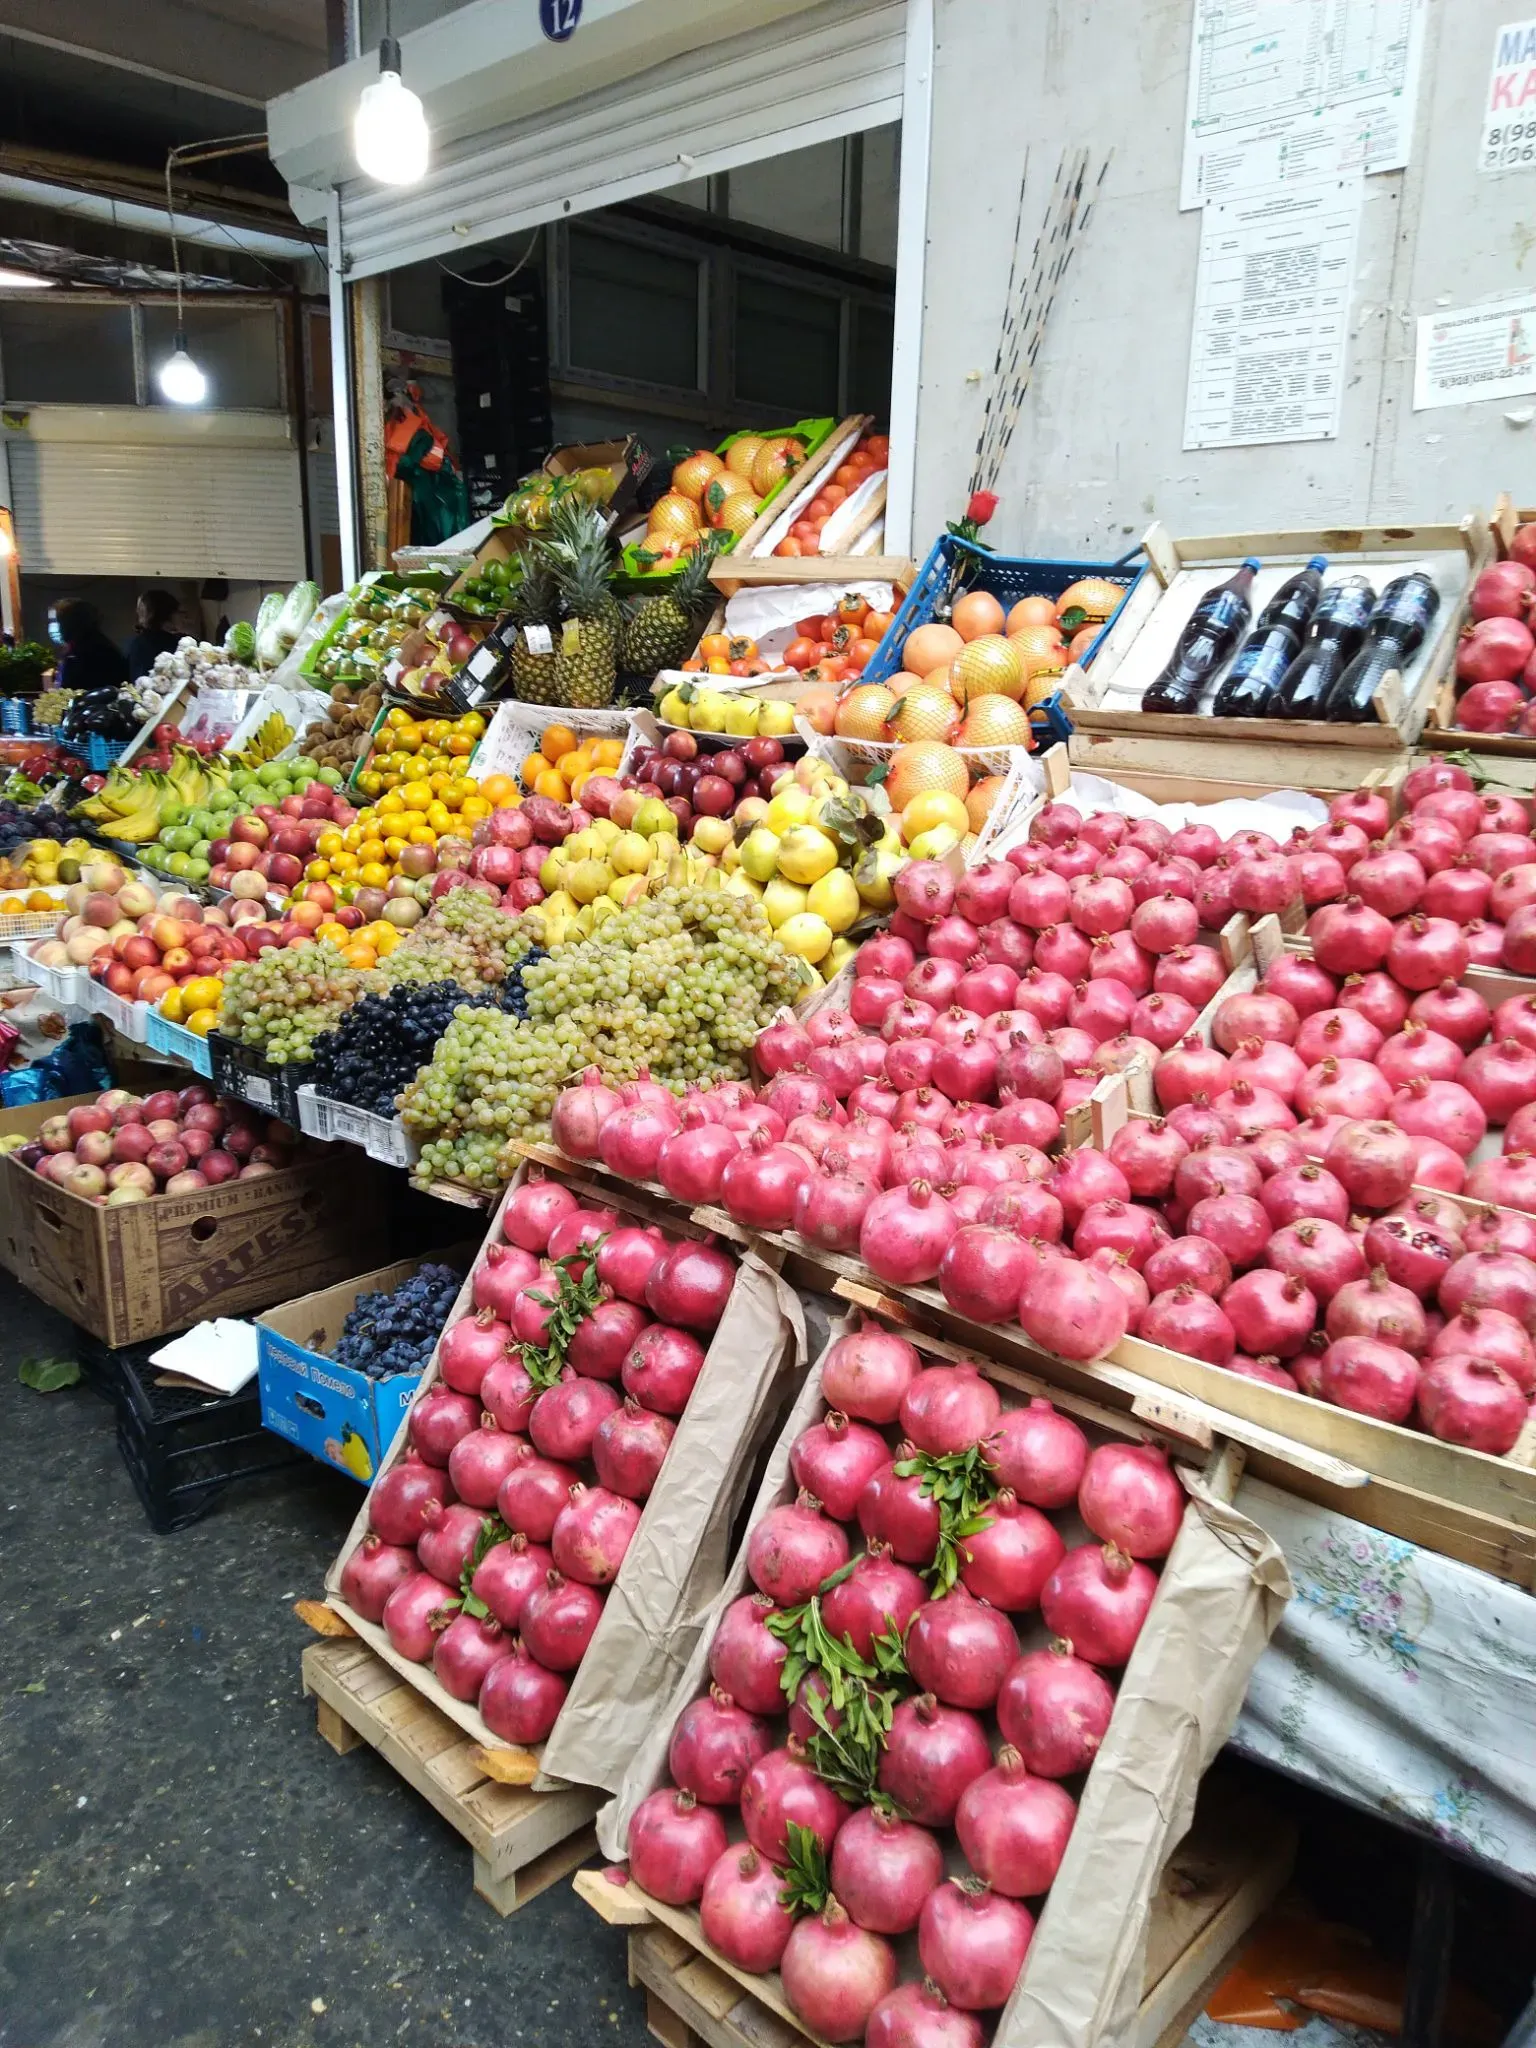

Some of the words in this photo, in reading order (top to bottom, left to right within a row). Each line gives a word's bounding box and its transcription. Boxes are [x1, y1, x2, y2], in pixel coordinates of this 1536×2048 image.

[549, 0, 575, 35] 12
[163, 1193, 240, 1219] PREMIUM
[311, 1367, 356, 1400] Помело
